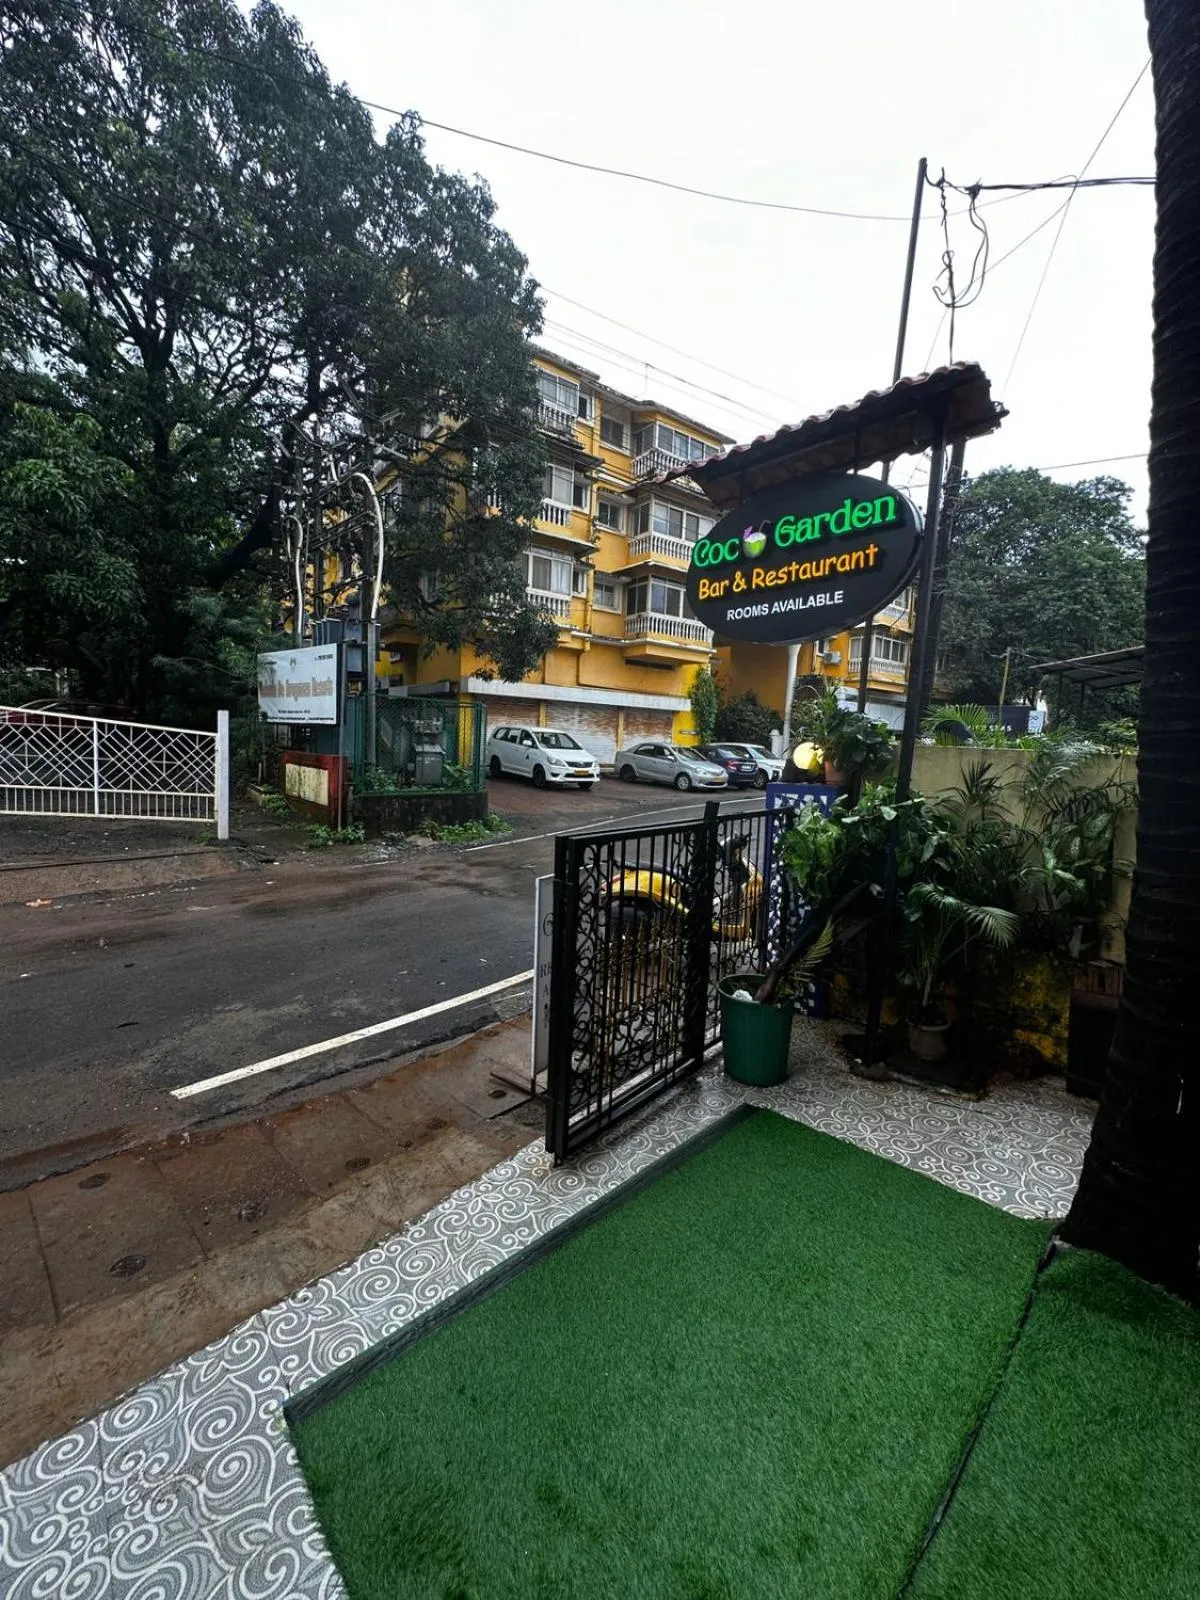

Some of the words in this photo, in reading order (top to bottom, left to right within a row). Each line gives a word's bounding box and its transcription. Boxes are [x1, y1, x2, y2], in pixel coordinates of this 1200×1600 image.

[774, 495, 897, 548] Garden
[698, 578, 729, 600] Bar
[732, 571, 747, 592] &
[752, 543, 878, 589] Restaurant
[726, 603, 769, 621] ROOMS
[771, 590, 844, 614] AVAILABLE
